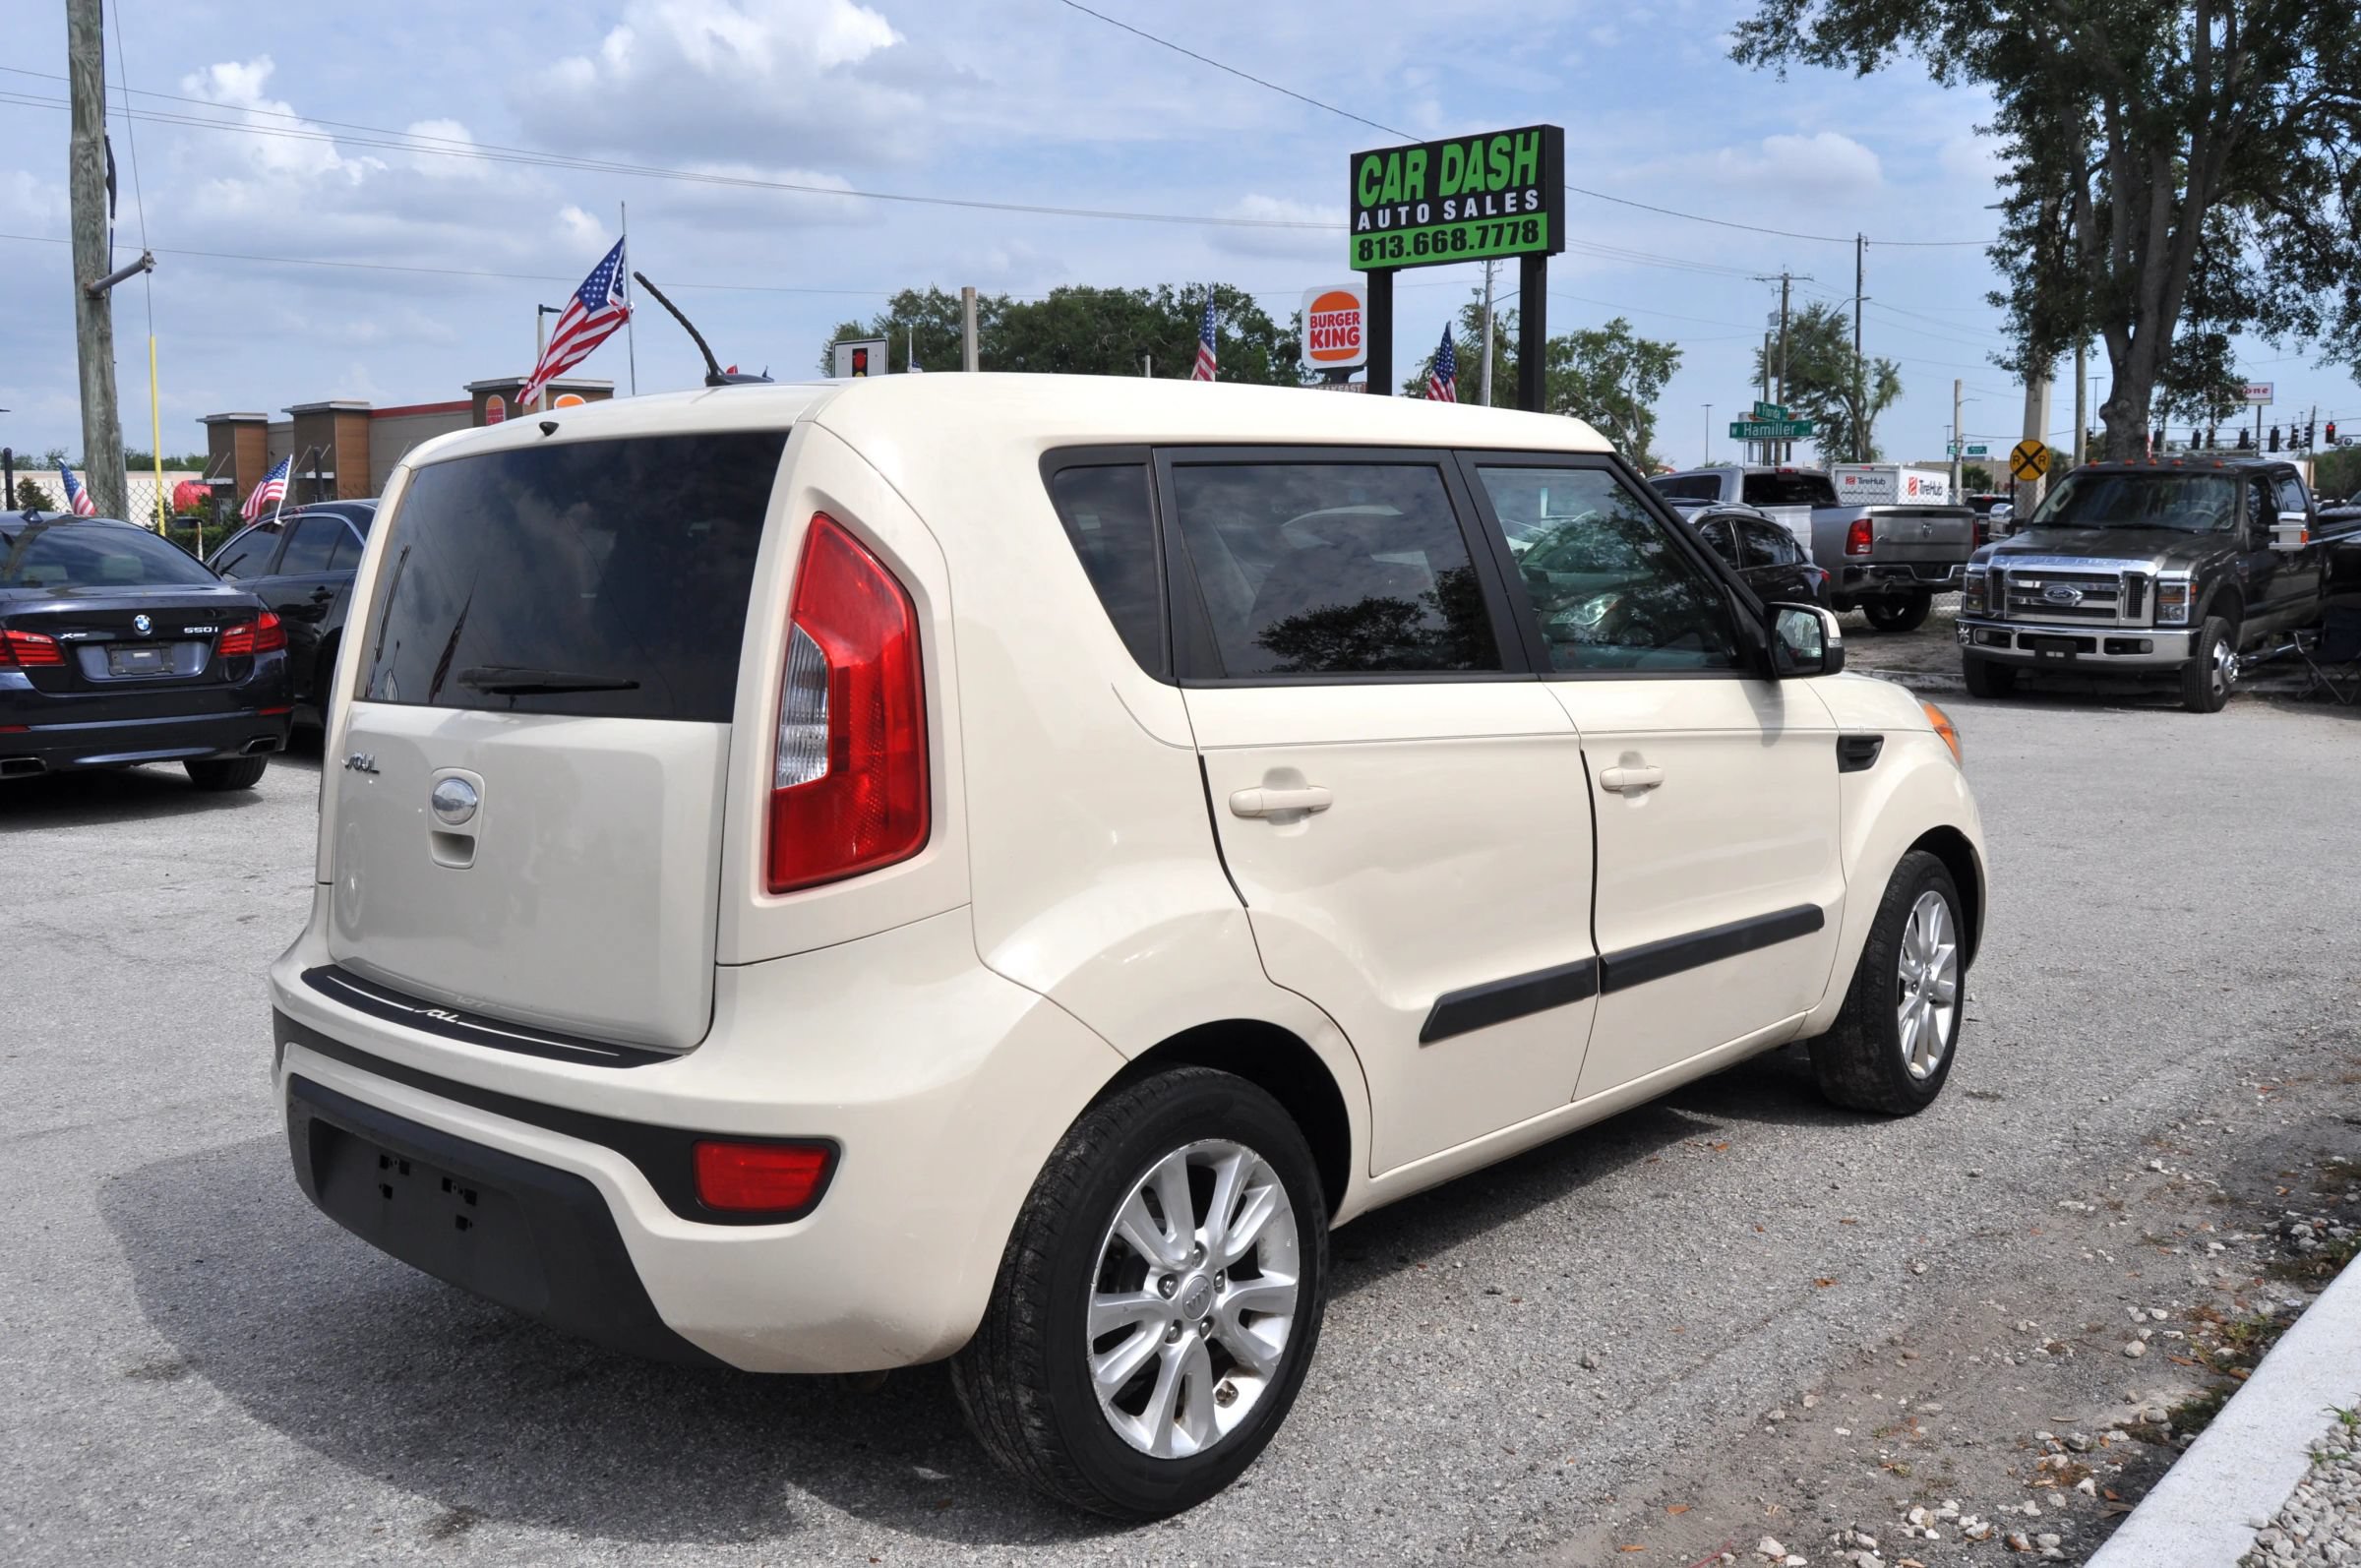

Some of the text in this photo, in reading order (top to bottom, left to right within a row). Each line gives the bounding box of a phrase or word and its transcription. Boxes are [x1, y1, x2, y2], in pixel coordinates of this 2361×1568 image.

[1358, 131, 1540, 208] CAR DASH
[1358, 189, 1539, 230] AUTO SALES
[1358, 219, 1539, 262] 813.668.7778
[1309, 311, 1361, 329] BURGER
[1309, 327, 1361, 349] KING
[1743, 421, 1796, 437] Hamiller
[2013, 454, 2020, 465] R
[2038, 454, 2046, 465] R
[1856, 476, 1886, 486] TireHub
[1918, 479, 1944, 496] TireHub
